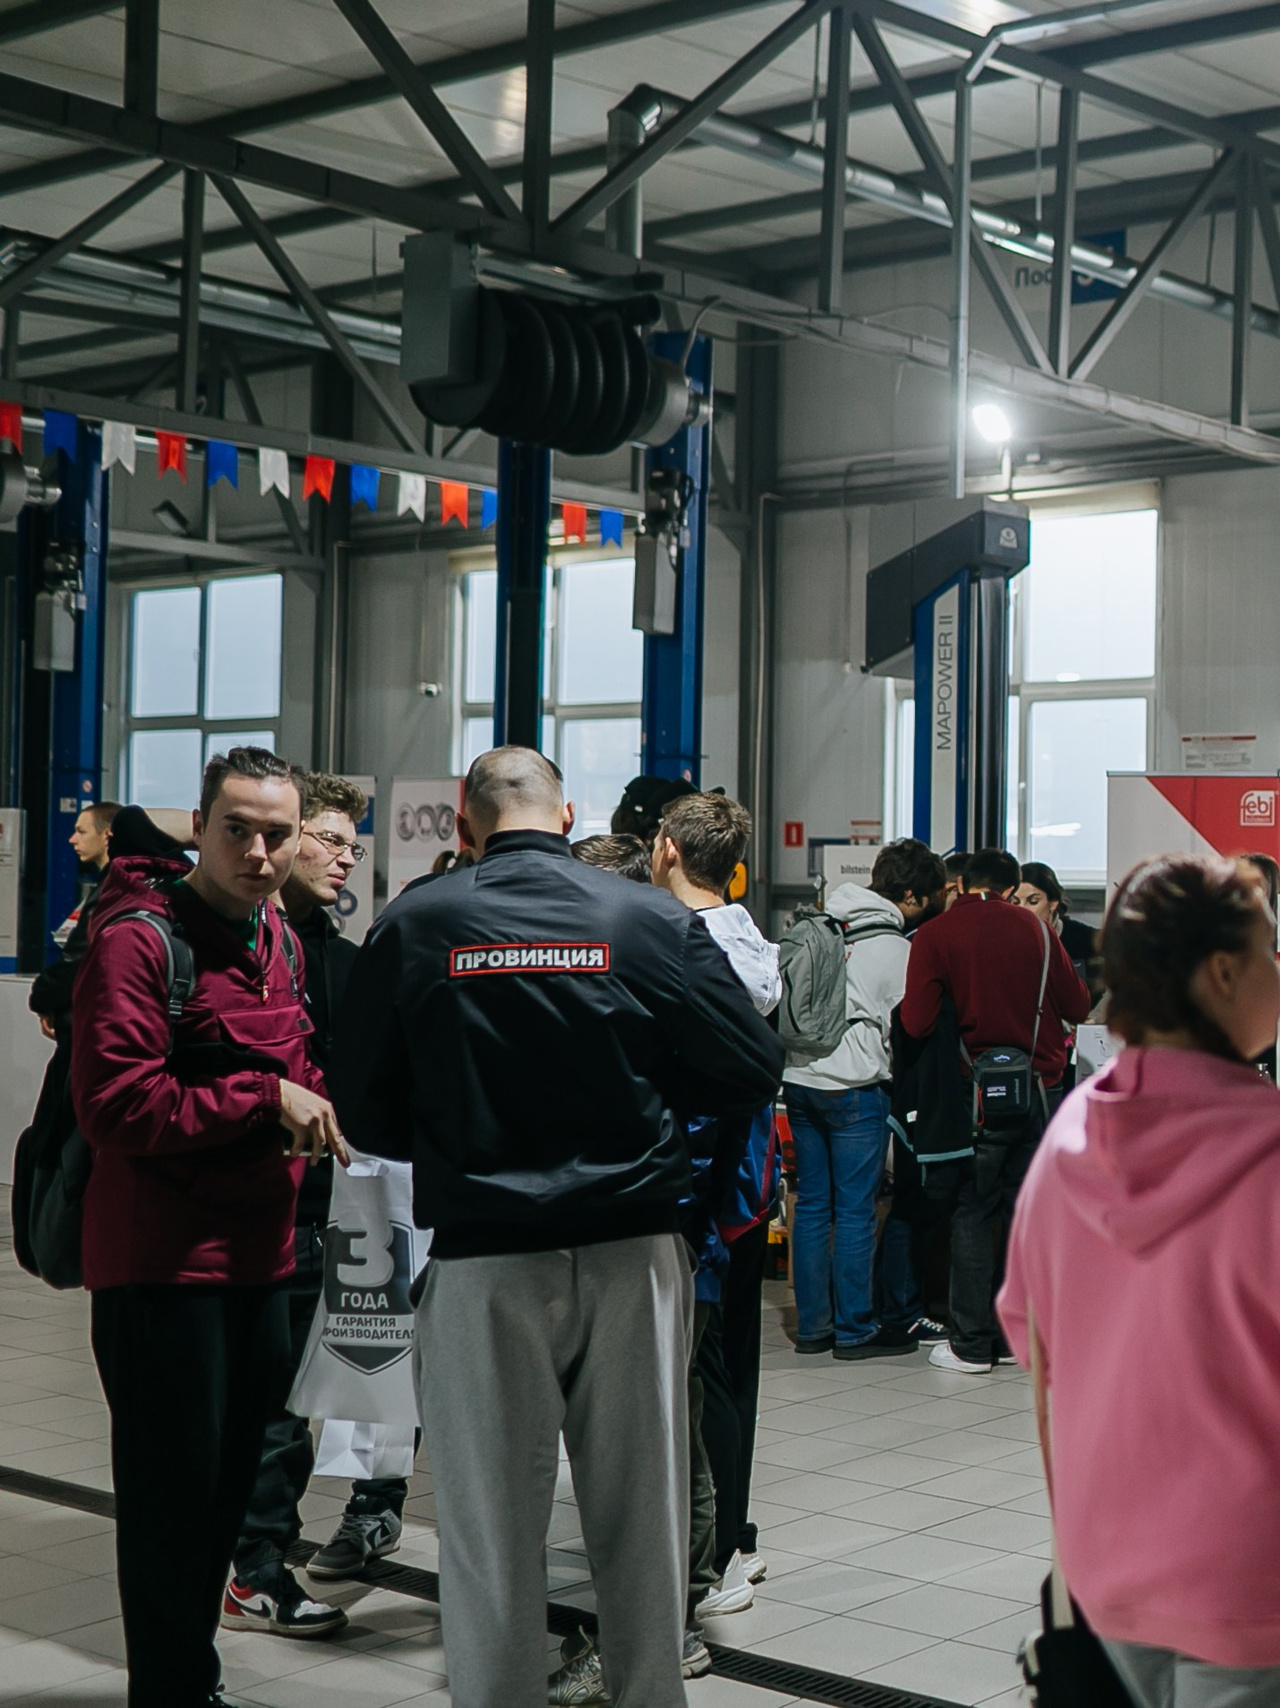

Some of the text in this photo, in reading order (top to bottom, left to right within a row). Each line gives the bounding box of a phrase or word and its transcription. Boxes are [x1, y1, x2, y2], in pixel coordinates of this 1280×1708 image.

[937, 631, 953, 750] MAPOWER
[456, 949, 604, 970] ПРОВИНЦИЯ
[337, 1210, 395, 1287] 3
[341, 1292, 389, 1310] ГОДА
[336, 1316, 396, 1327] ГАРАНТИЯ
